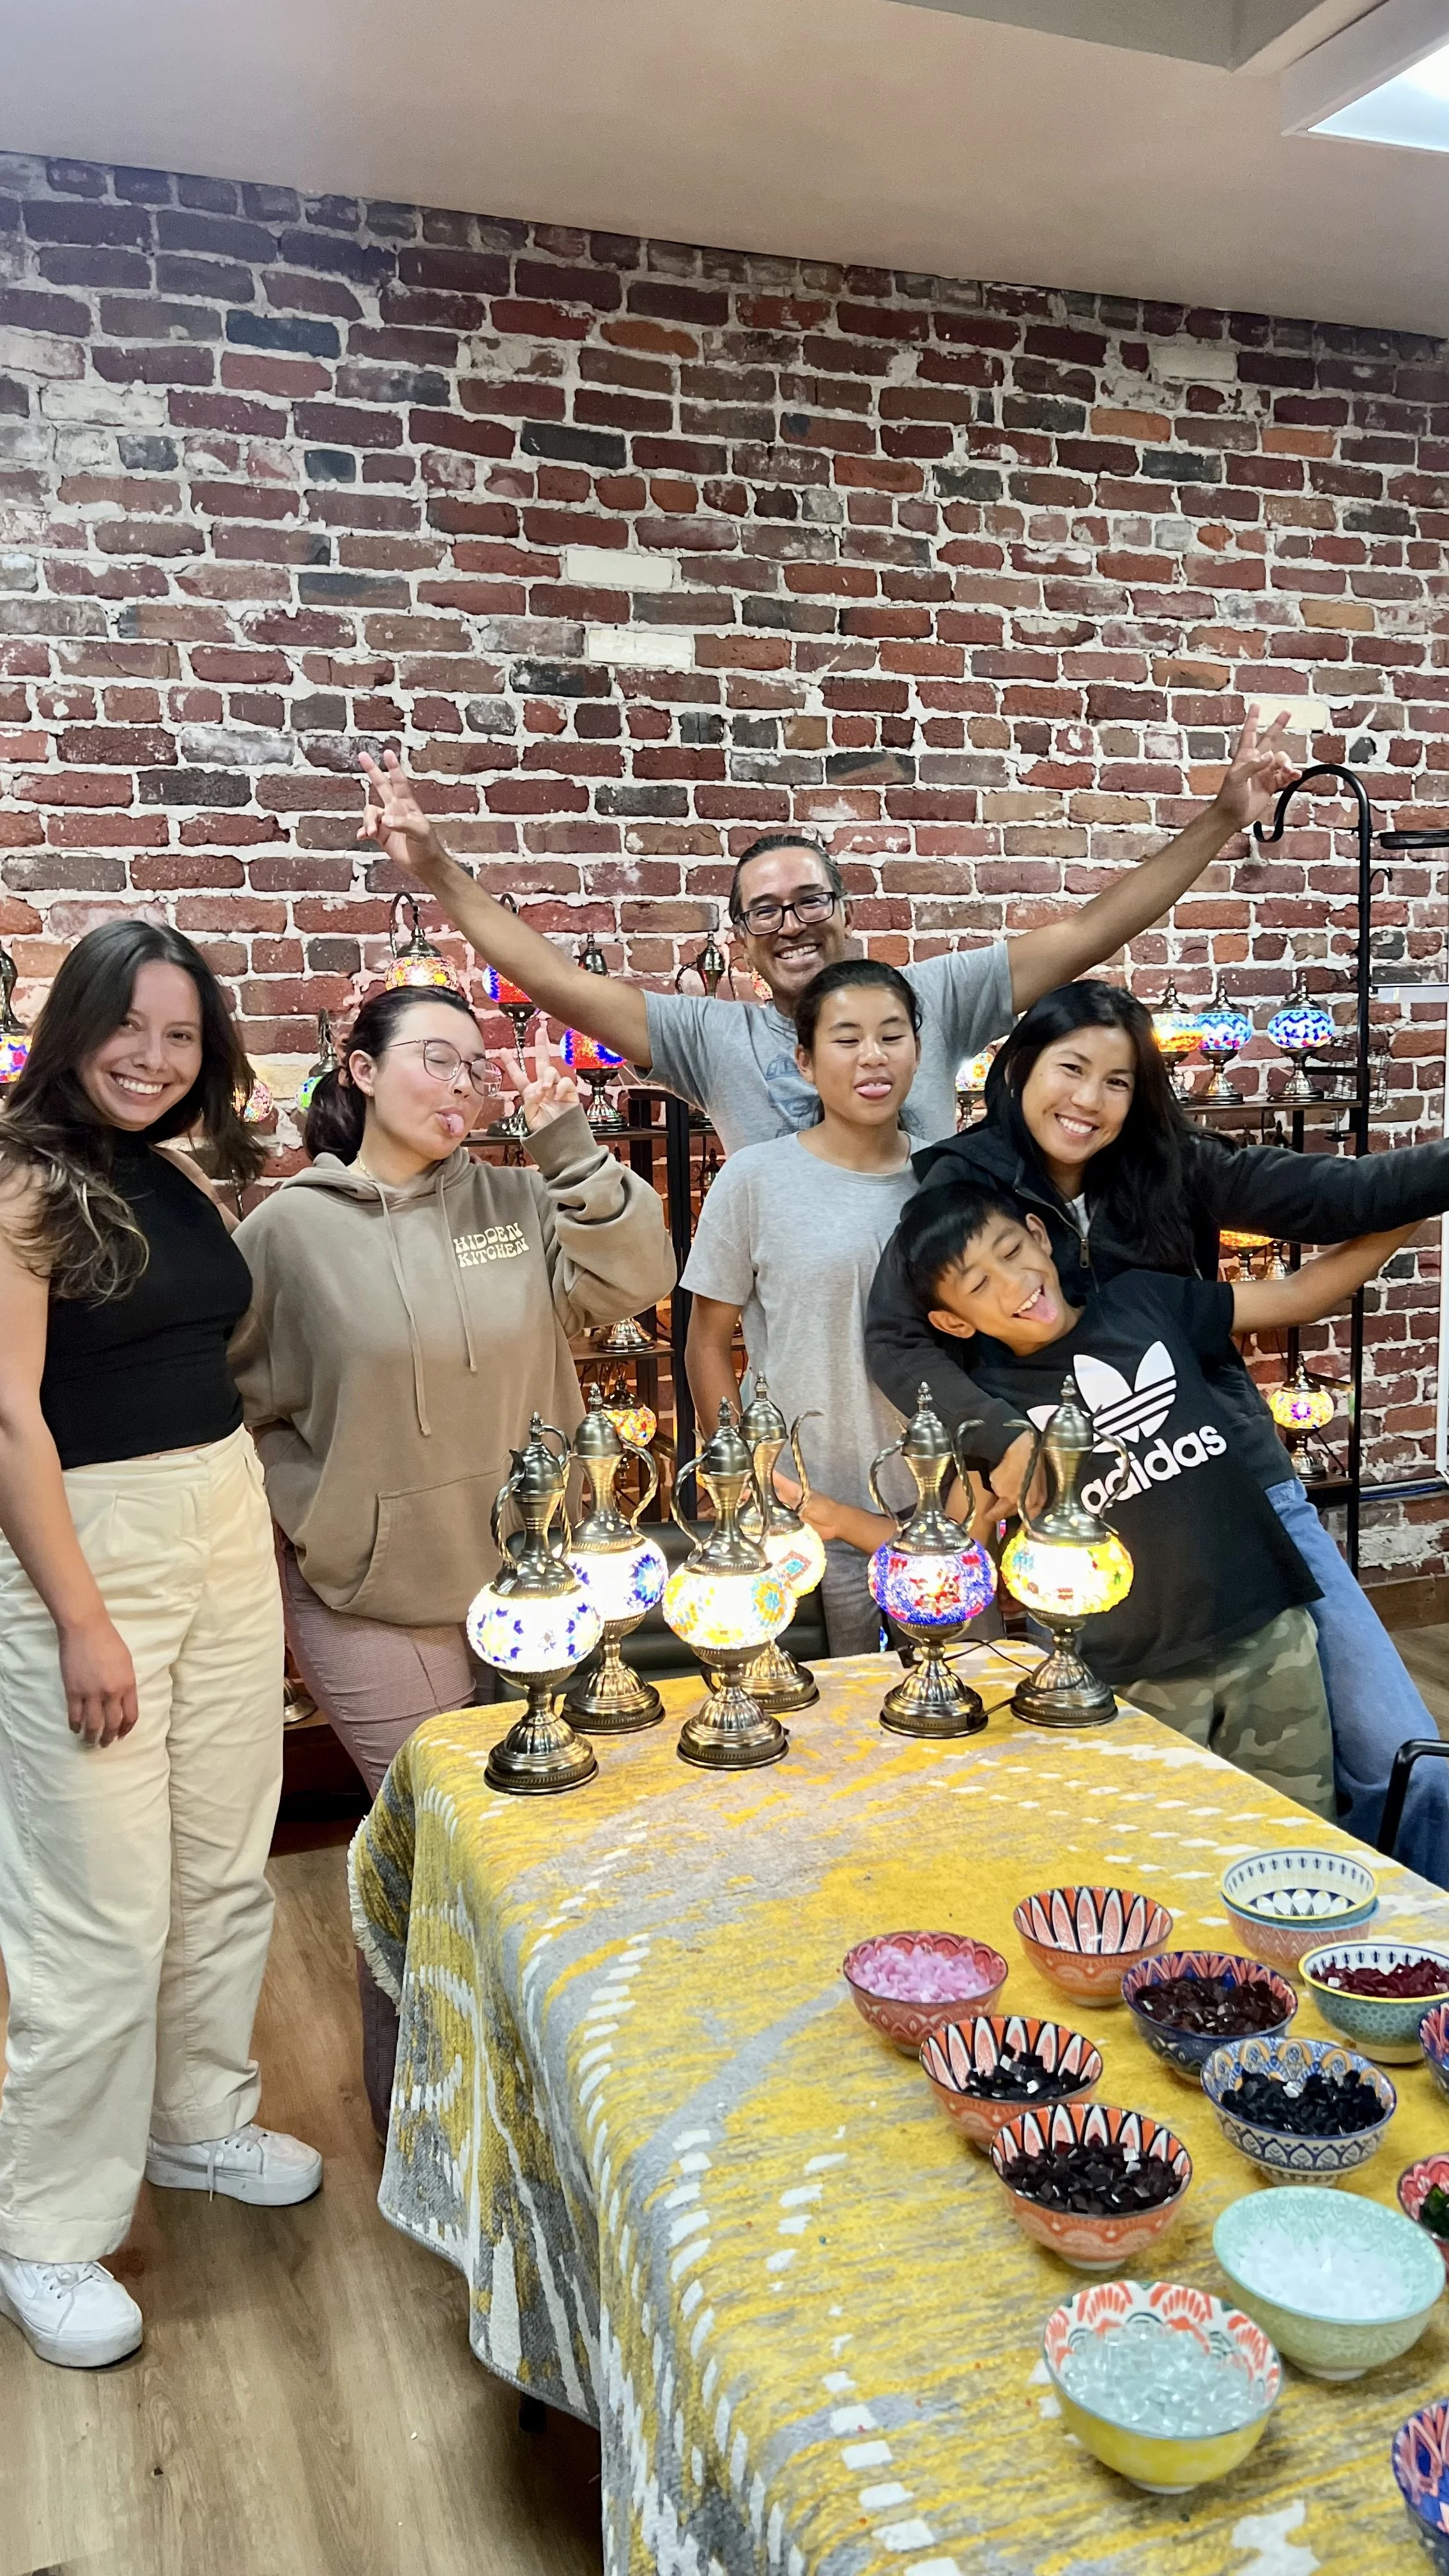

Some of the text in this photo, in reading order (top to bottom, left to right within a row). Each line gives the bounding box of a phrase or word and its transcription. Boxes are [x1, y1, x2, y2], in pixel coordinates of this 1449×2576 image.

[453, 1222, 523, 1254] HIDDEN
[457, 1238, 530, 1268] KITCHEN
[1080, 1425, 1227, 1514] adidas
